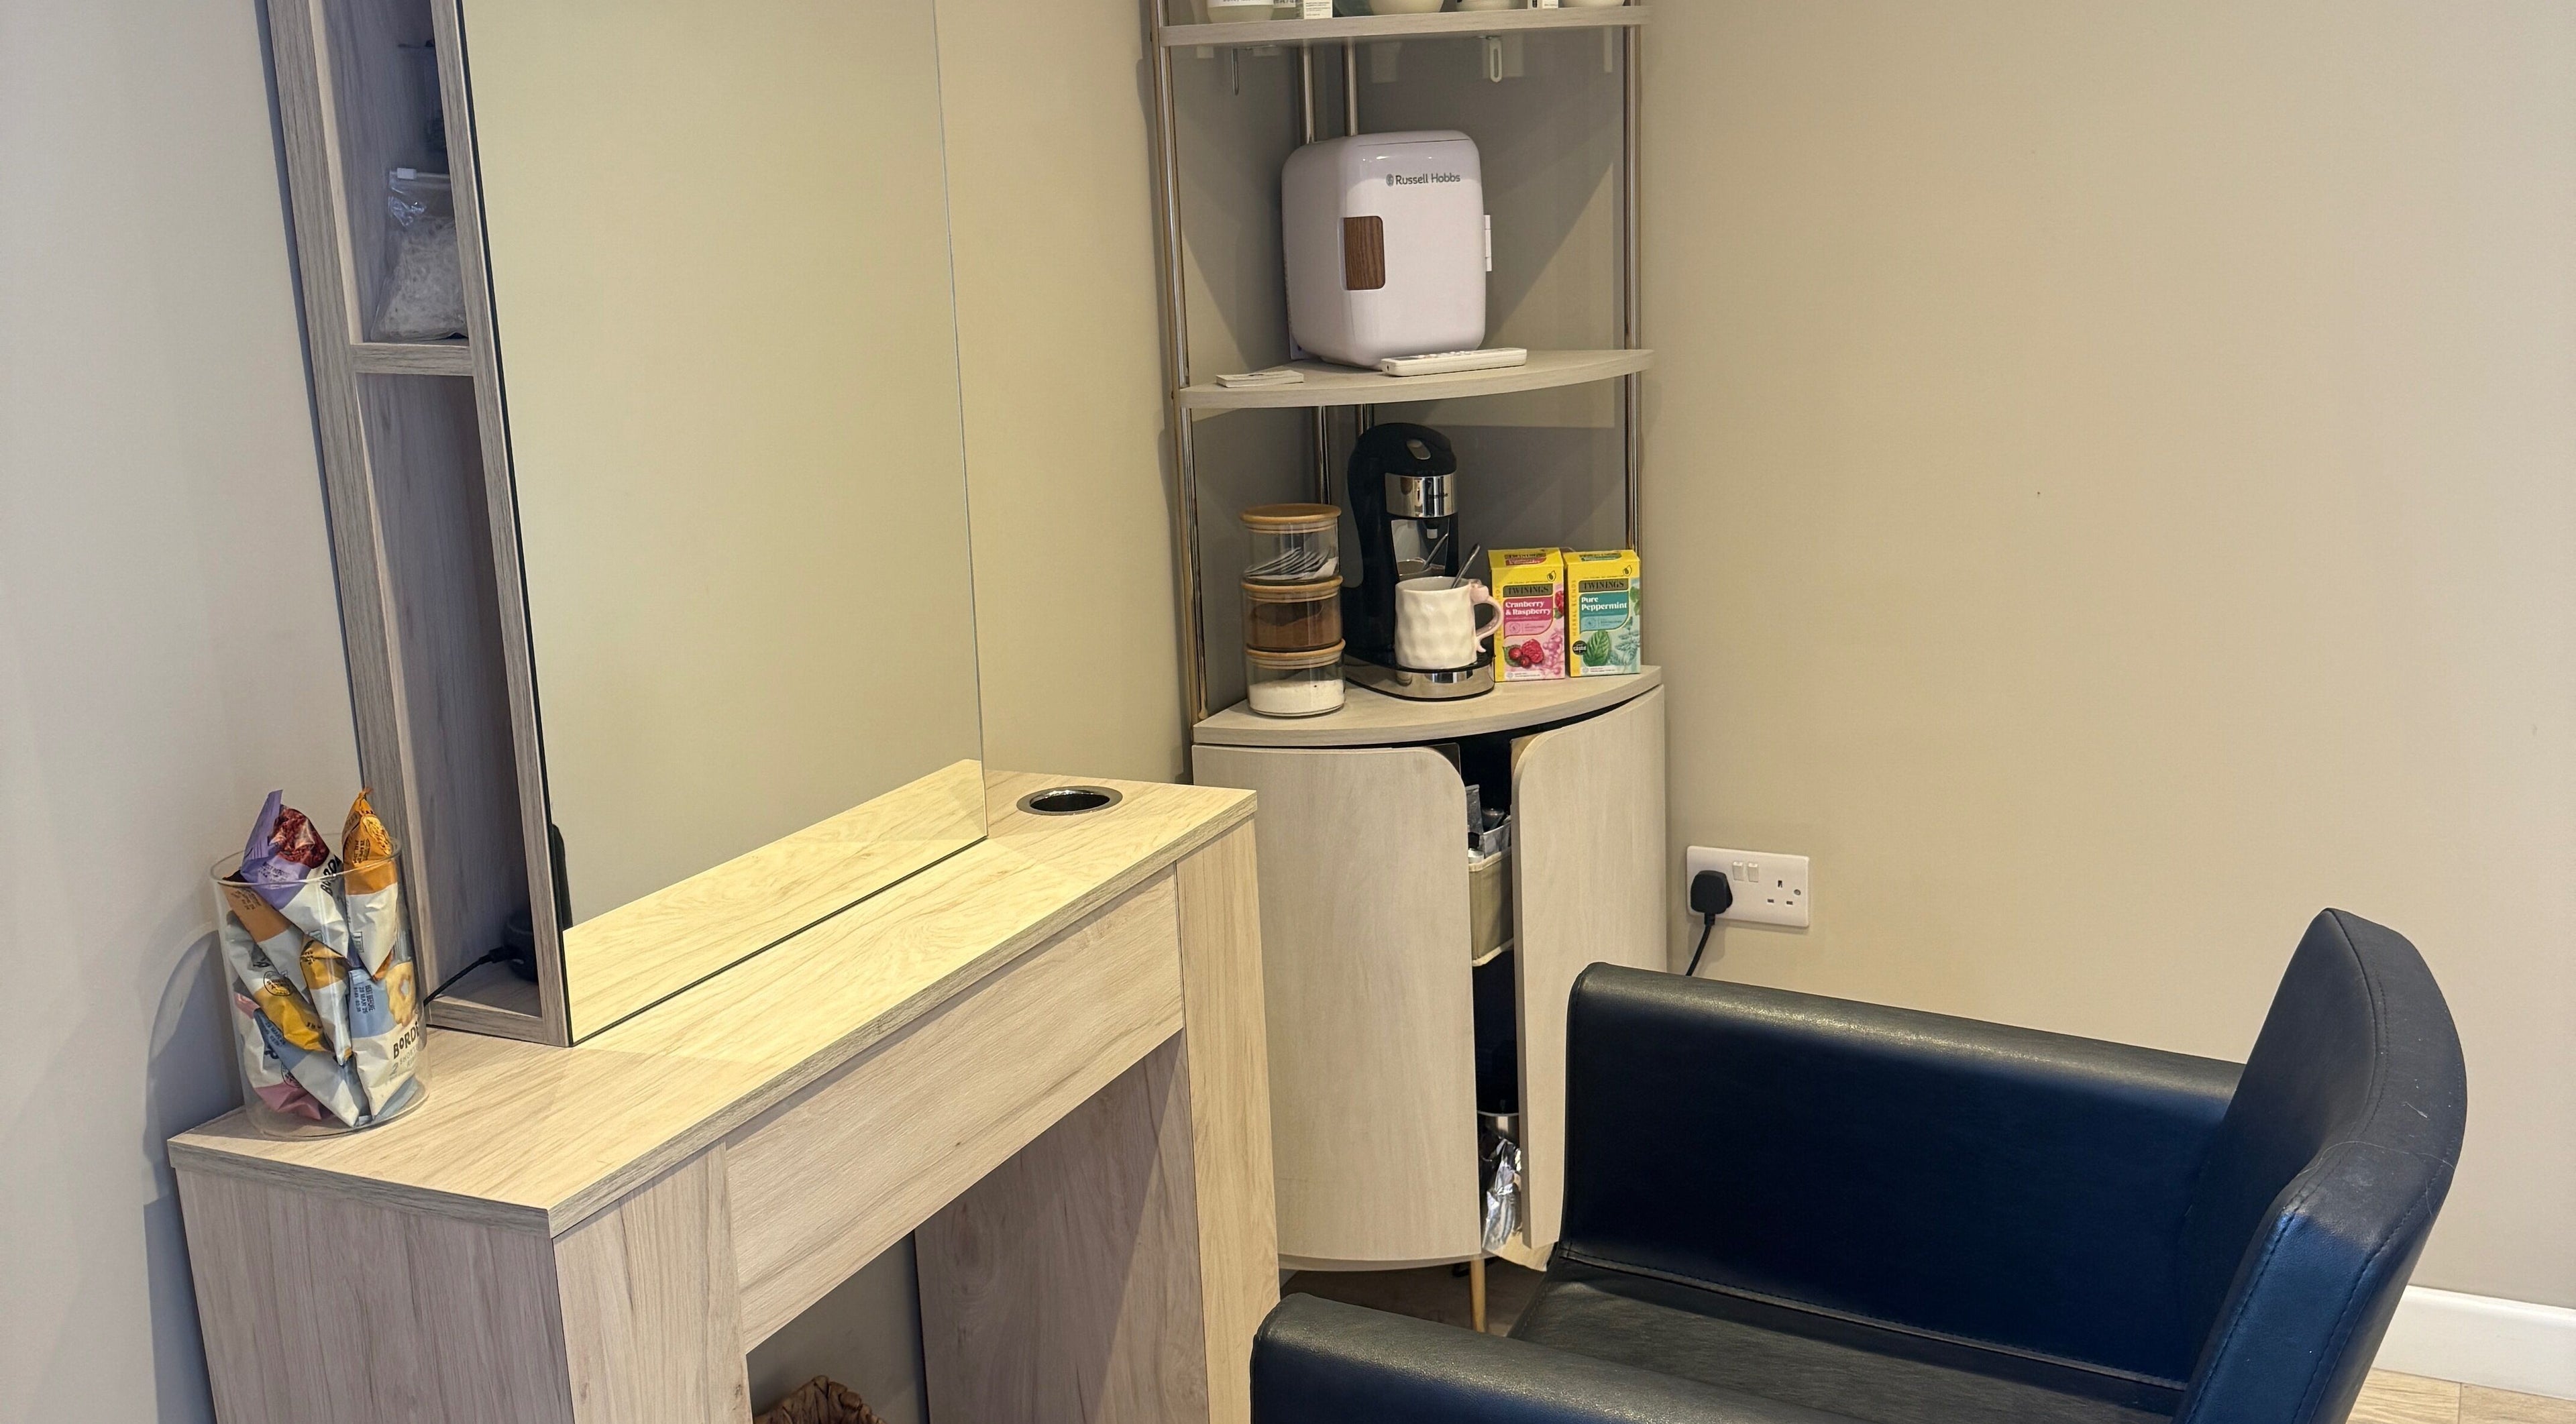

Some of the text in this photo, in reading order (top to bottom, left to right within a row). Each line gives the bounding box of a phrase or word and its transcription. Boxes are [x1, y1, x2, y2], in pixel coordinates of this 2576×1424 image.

[1395, 172, 1460, 184] Russell Hobbs
[1584, 581, 1623, 590] TWININGS
[1509, 586, 1548, 595] TWININGS
[1581, 602, 1627, 612] Peppermint
